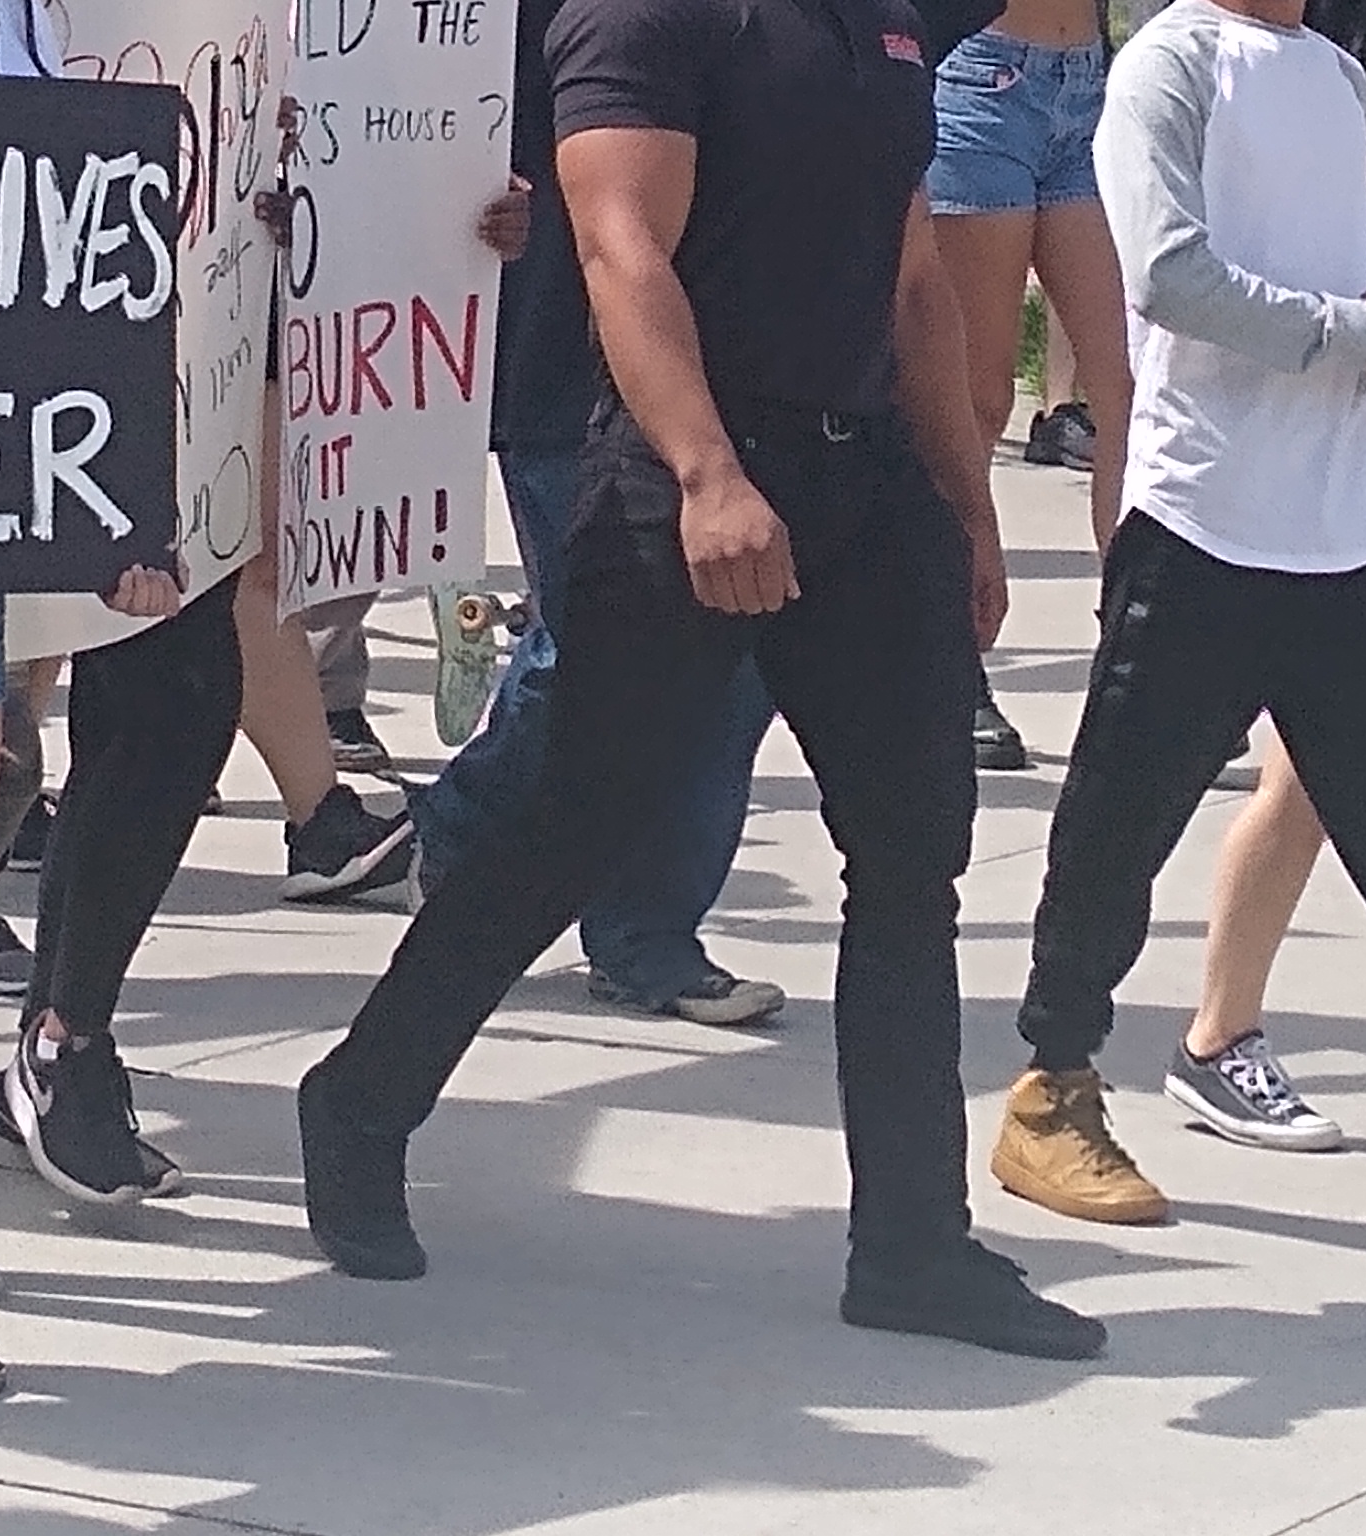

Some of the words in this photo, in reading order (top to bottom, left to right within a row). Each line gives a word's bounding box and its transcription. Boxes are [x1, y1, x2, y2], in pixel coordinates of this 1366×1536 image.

[412, 0, 487, 47] THE
[365, 106, 457, 143] HOUSE
[287, 293, 480, 421] BURN
[321, 434, 353, 501] IT
